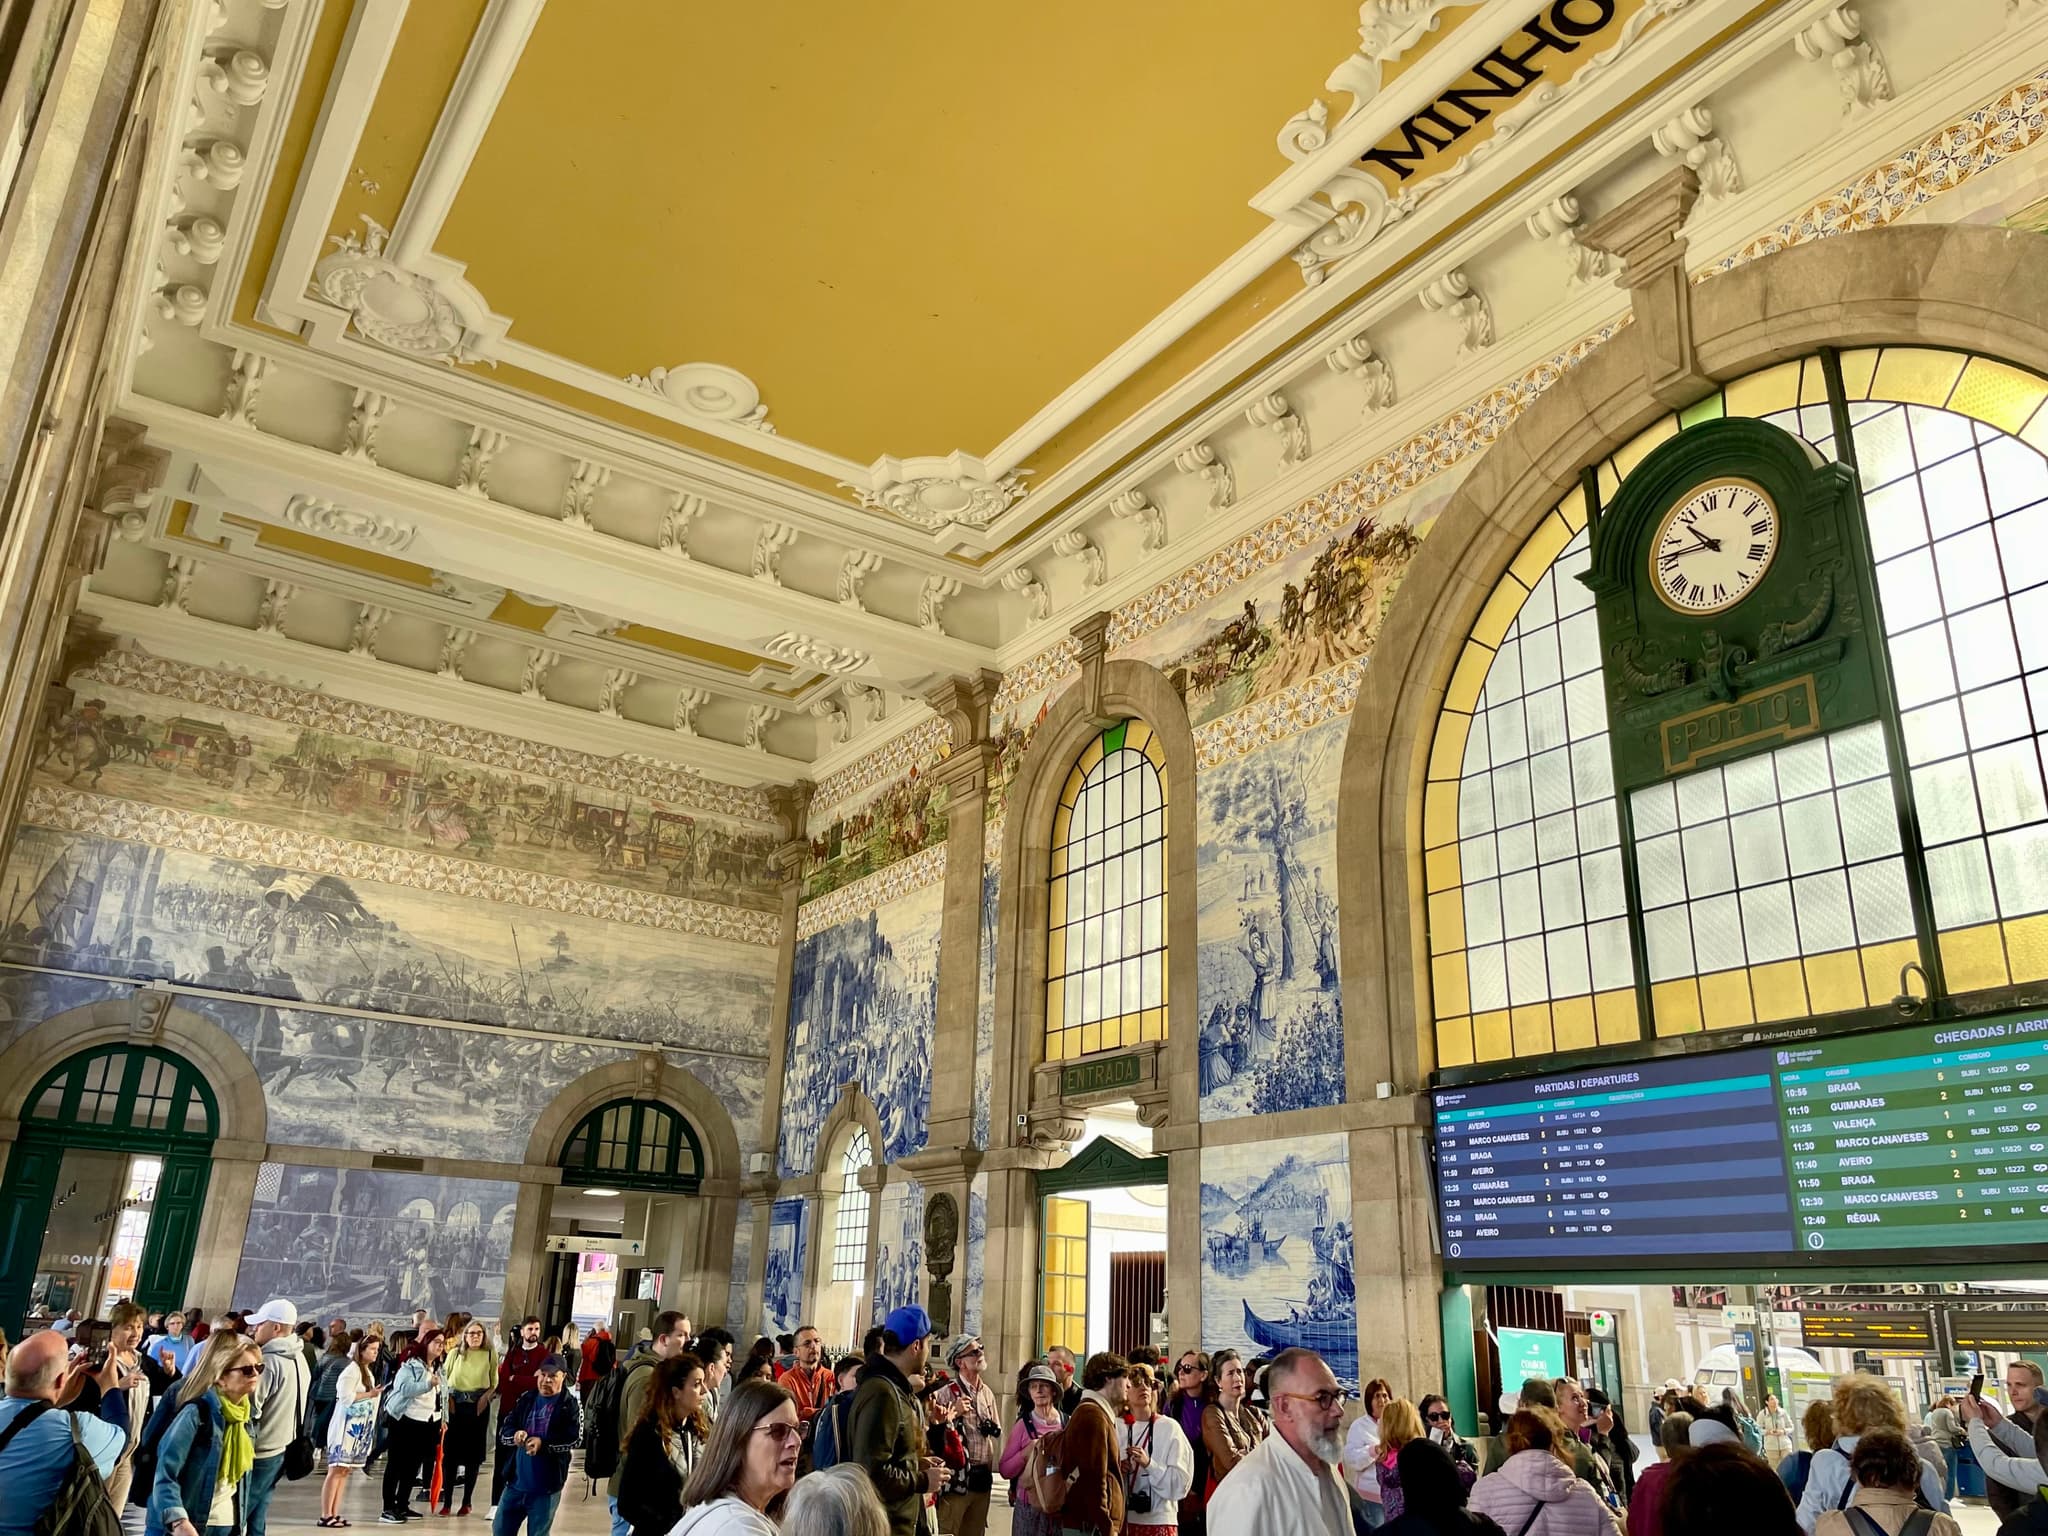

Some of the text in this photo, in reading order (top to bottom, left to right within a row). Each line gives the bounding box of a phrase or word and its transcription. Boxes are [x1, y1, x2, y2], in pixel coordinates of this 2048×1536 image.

[1361, 0, 1615, 181] MINHO
[1701, 495, 1718, 514] XII
[1743, 501, 1759, 517] II
[1680, 510, 1698, 526] XI
[1751, 519, 1768, 536] III
[1747, 544, 1766, 561] IIII
[1670, 574, 1688, 596] VIII
[1688, 585, 1704, 602] VII
[1713, 584, 1726, 600] VI
[1684, 693, 1790, 755] PORTO
[1934, 1025, 2006, 1044] CHEGADAS
[1067, 1060, 1133, 1089] ENTRADA
[1534, 1080, 1575, 1094] PARTIDAS
[1581, 1073, 1640, 1088] DEPARTURES
[1785, 1088, 1808, 1097] 10:55
[1828, 1082, 1861, 1093] BRAGA
[1788, 1106, 1809, 1116] 11:10
[1830, 1098, 1886, 1111] GUIMARÃES
[1940, 1091, 1948, 1100] 2
[1468, 1122, 1490, 1130] AVEIRO
[1790, 1124, 1812, 1133] 11:25
[1833, 1118, 1876, 1130] VALENÇA
[1944, 1110, 1949, 1119] 1
[1469, 1137, 1491, 1145] MARCO
[1492, 1133, 1530, 1142] CANAVESES
[1793, 1142, 1815, 1152] 11:30
[1836, 1136, 1869, 1148] MARCO
[1872, 1132, 1929, 1145] CANAVESES
[1470, 1152, 1492, 1160] BRAGA
[1796, 1160, 1818, 1170] 11:40
[1839, 1156, 1872, 1166] AVEIRO
[1950, 1149, 1957, 1158] 3
[1472, 1167, 1494, 1175] AVEIRO
[1798, 1179, 1820, 1188] 11:50
[1841, 1176, 1875, 1185] BRAGA
[1954, 1169, 1960, 1178] 2
[1473, 1181, 1509, 1190] GUIMARÃES
[1497, 1196, 1535, 1204] CANAVESES
[1801, 1197, 1823, 1207] 12:30
[1844, 1195, 1878, 1204] MARCO
[1880, 1191, 1938, 1202] CANAVESES
[1475, 1213, 1497, 1221] BRAGA
[1803, 1216, 1826, 1225] 12:40
[1846, 1212, 1880, 1223] RÉGUA
[1960, 1209, 1967, 1218] 2
